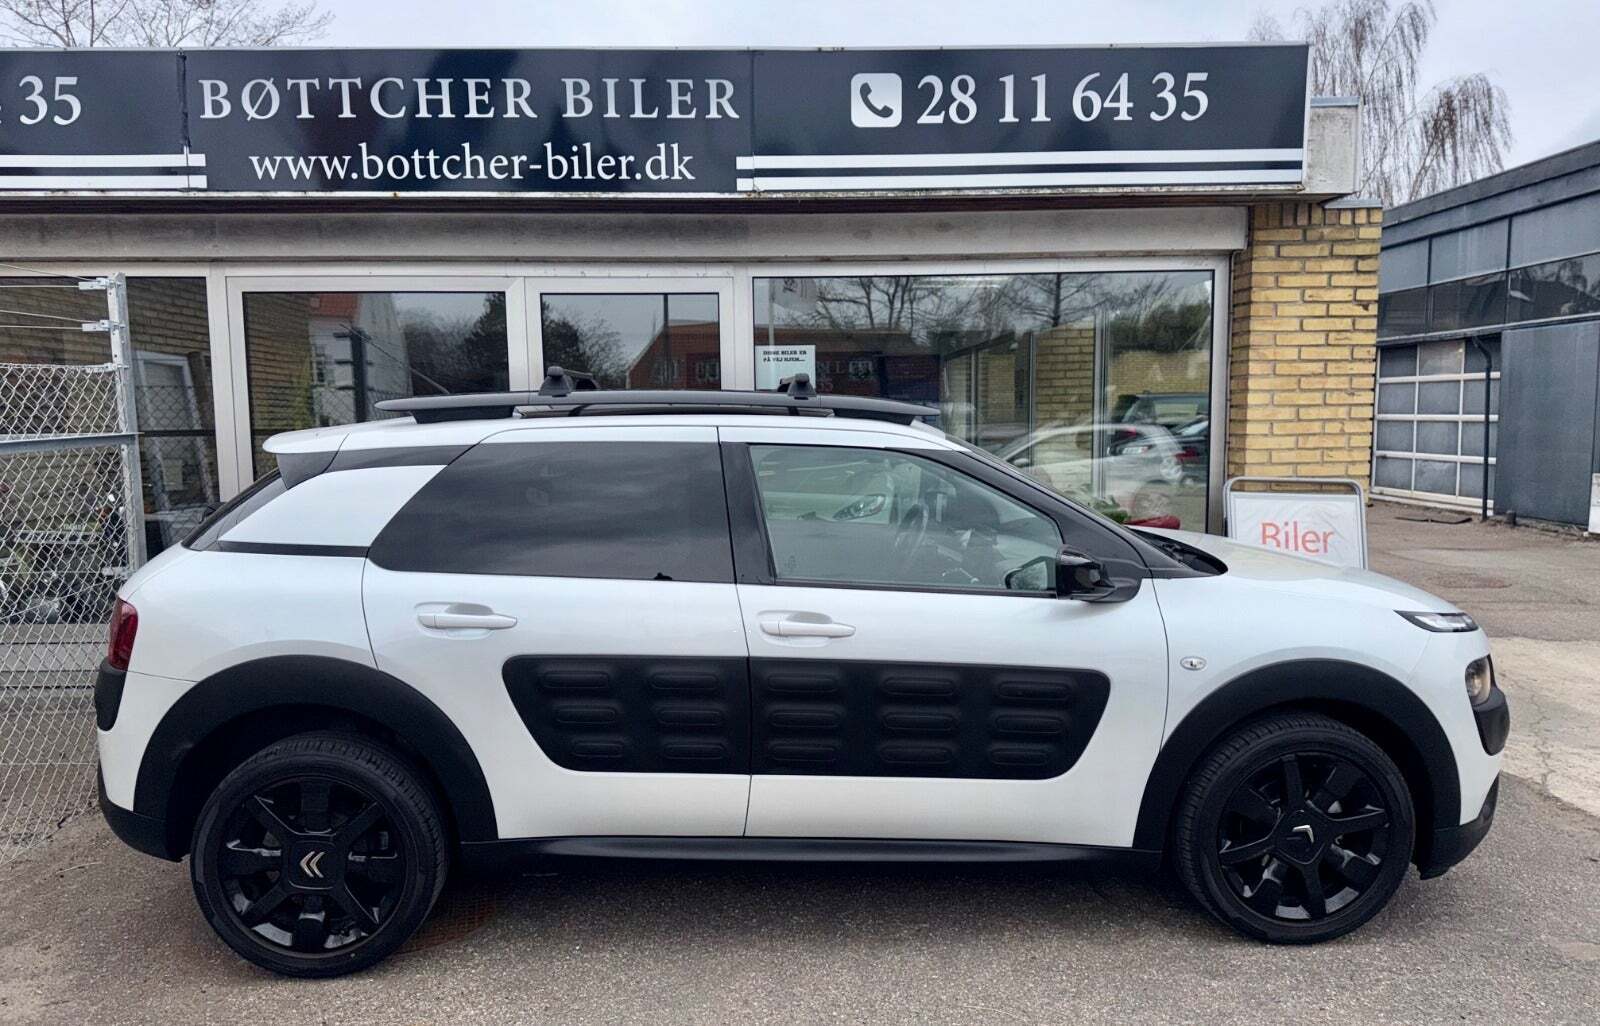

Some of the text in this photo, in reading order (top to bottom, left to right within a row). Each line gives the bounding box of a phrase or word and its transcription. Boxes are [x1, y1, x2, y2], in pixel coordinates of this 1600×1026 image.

[18, 75, 82, 126] 35
[198, 77, 740, 121] BØTTCHER BILER
[916, 71, 1210, 125] 28 11 64 35
[249, 142, 696, 182] www.bottcher-biler.dk
